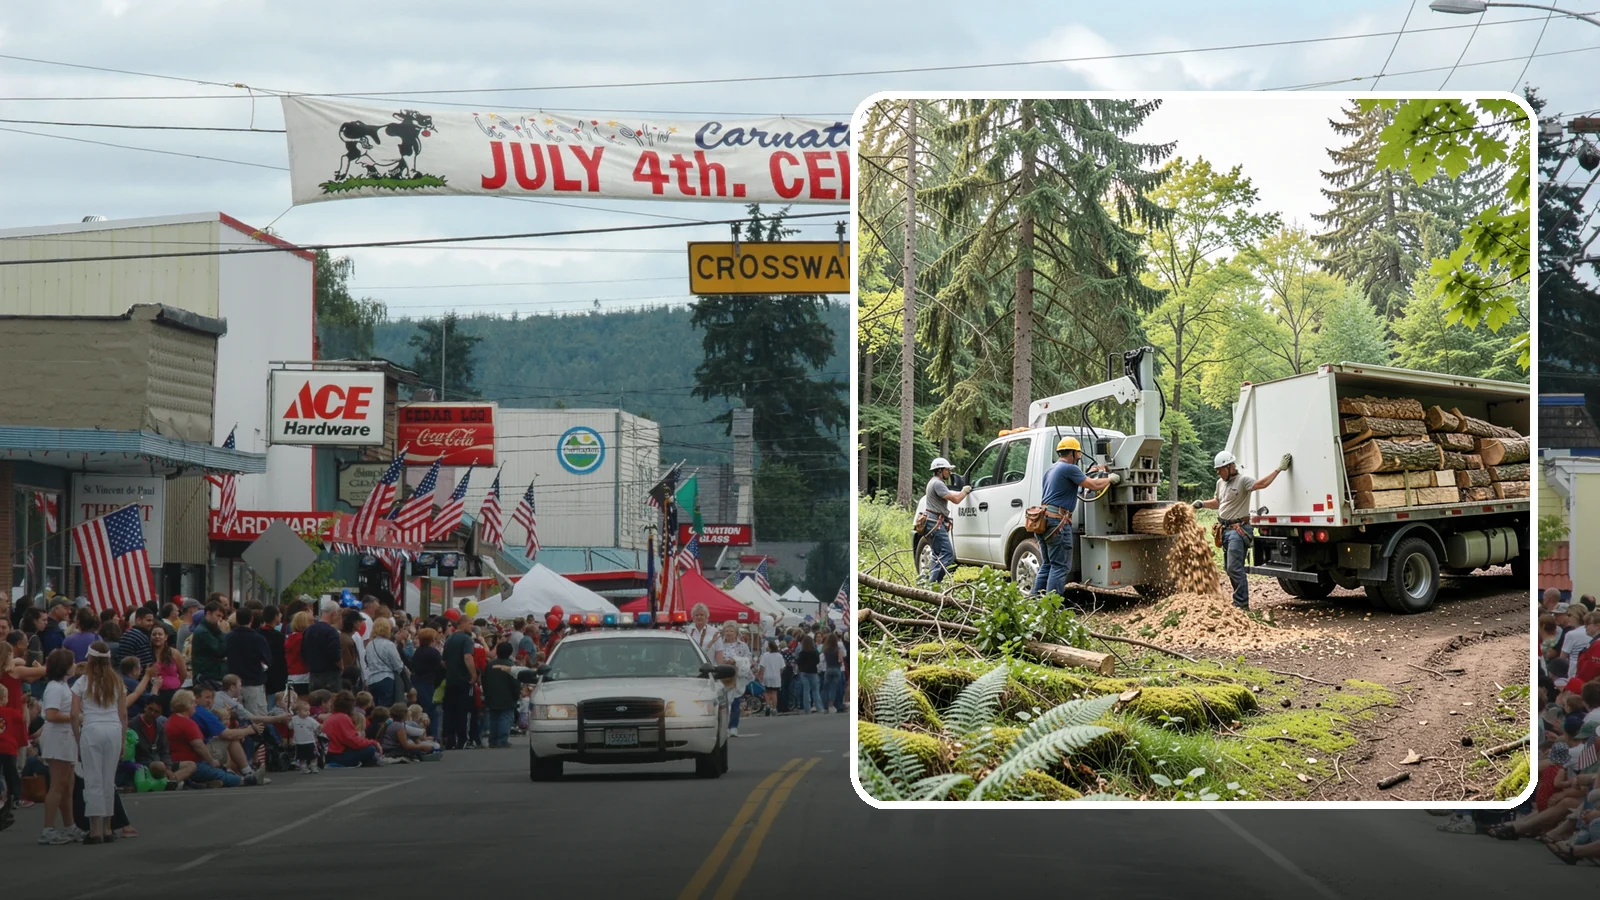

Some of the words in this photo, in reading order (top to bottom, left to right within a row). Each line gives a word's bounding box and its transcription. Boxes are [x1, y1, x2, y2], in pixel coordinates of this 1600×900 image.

[481, 140, 605, 192] JULY
[632, 149, 746, 198] 4th.
[697, 254, 850, 280] CROSSWA
[282, 380, 373, 420] ACE
[405, 409, 452, 422] CEDAR
[283, 421, 371, 437] Hardware
[416, 428, 477, 447] Coca-Cola
[353, 466, 387, 481] Simpl
[83, 484, 94, 495] St.
[95, 485, 124, 495] Vincent
[126, 486, 136, 495] de
[137, 485, 155, 496] Paul
[81, 503, 154, 522] THRT
[688, 526, 742, 535] CRNATION
[699, 535, 730, 543] GLASS
